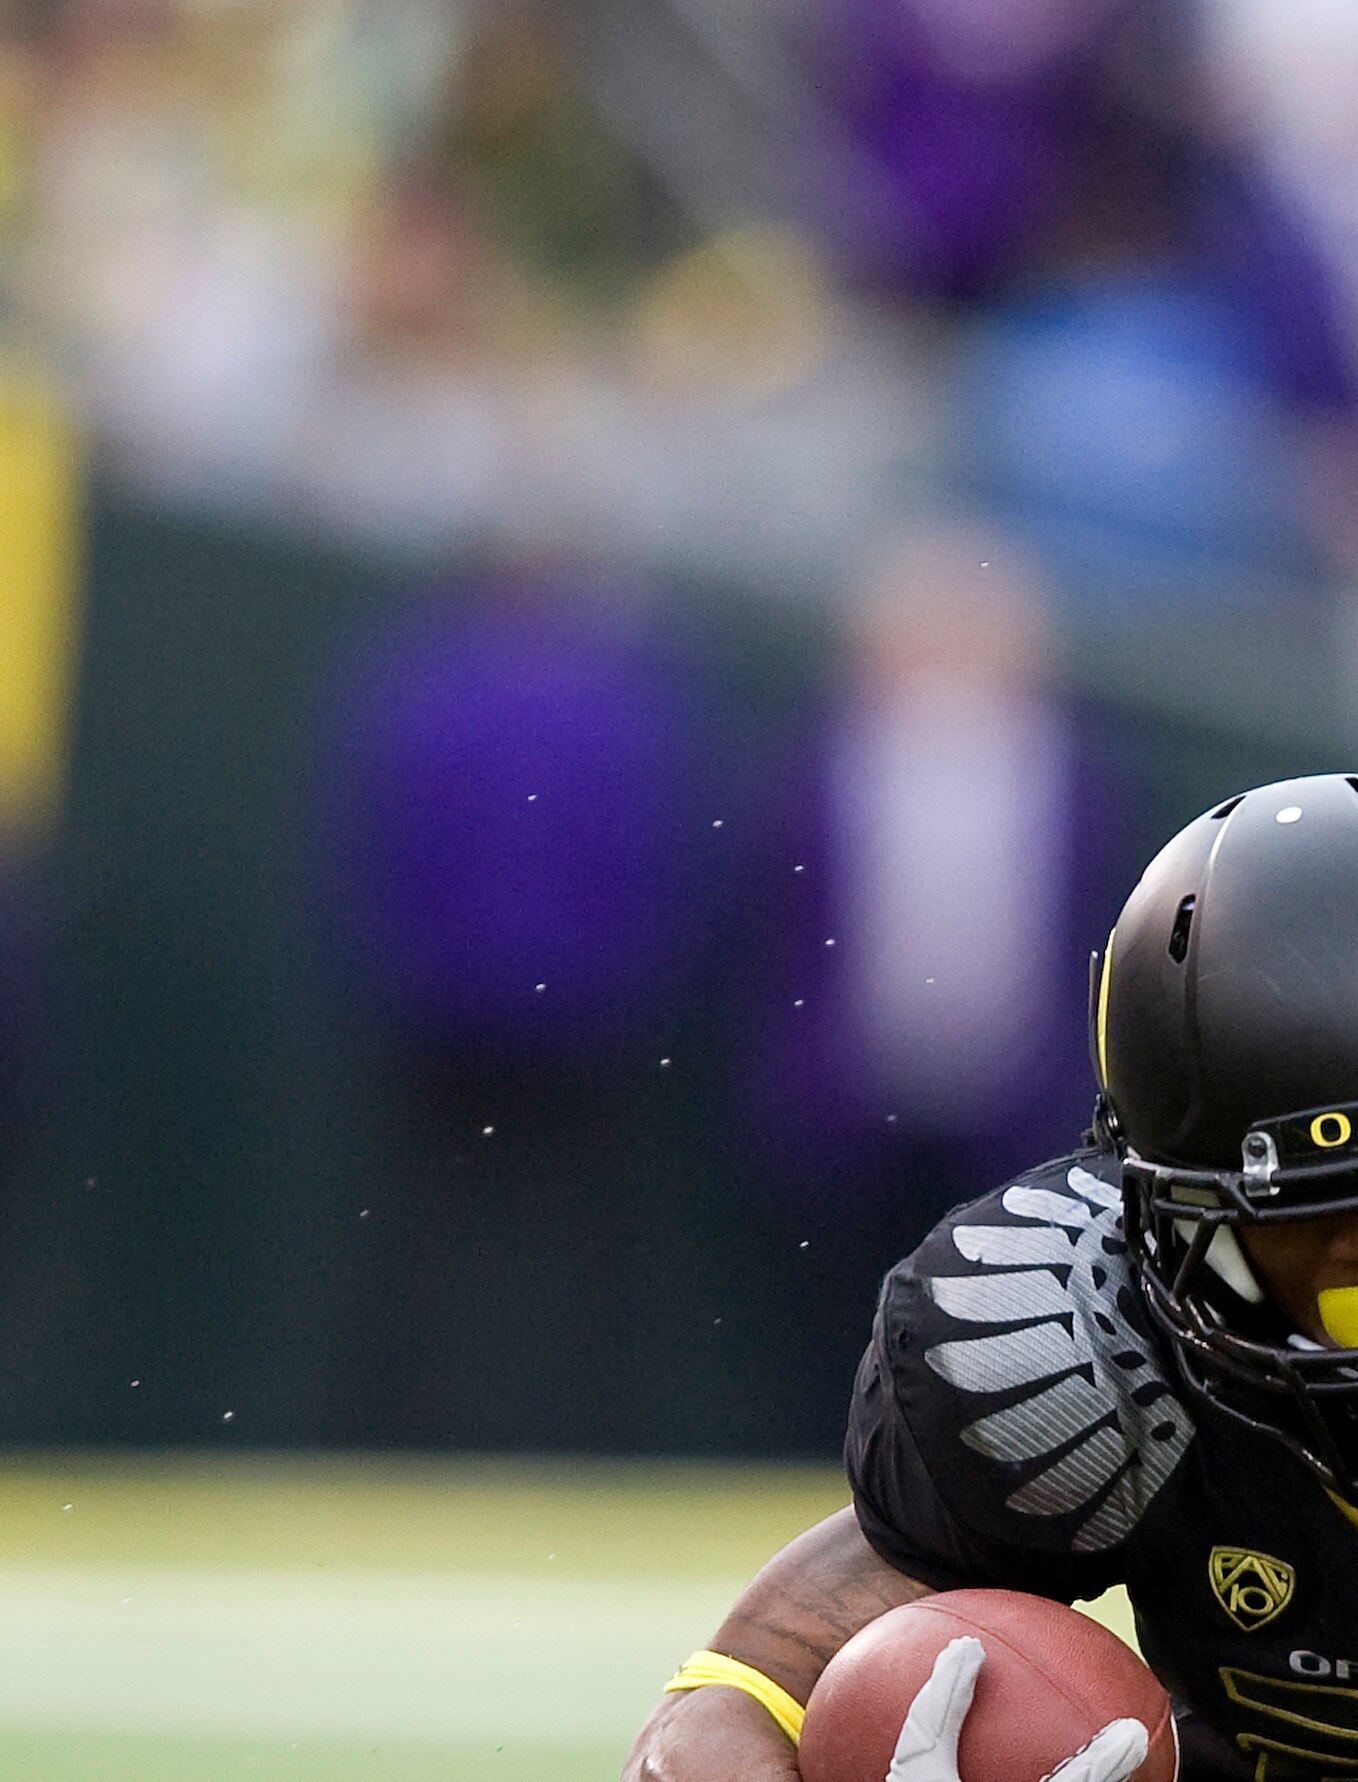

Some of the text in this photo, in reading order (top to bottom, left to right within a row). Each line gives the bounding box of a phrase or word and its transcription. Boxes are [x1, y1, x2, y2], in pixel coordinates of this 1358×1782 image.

[1310, 1112, 1351, 1148] O
[1213, 1552, 1289, 1605] PAC
[1230, 1583, 1275, 1616] 10
